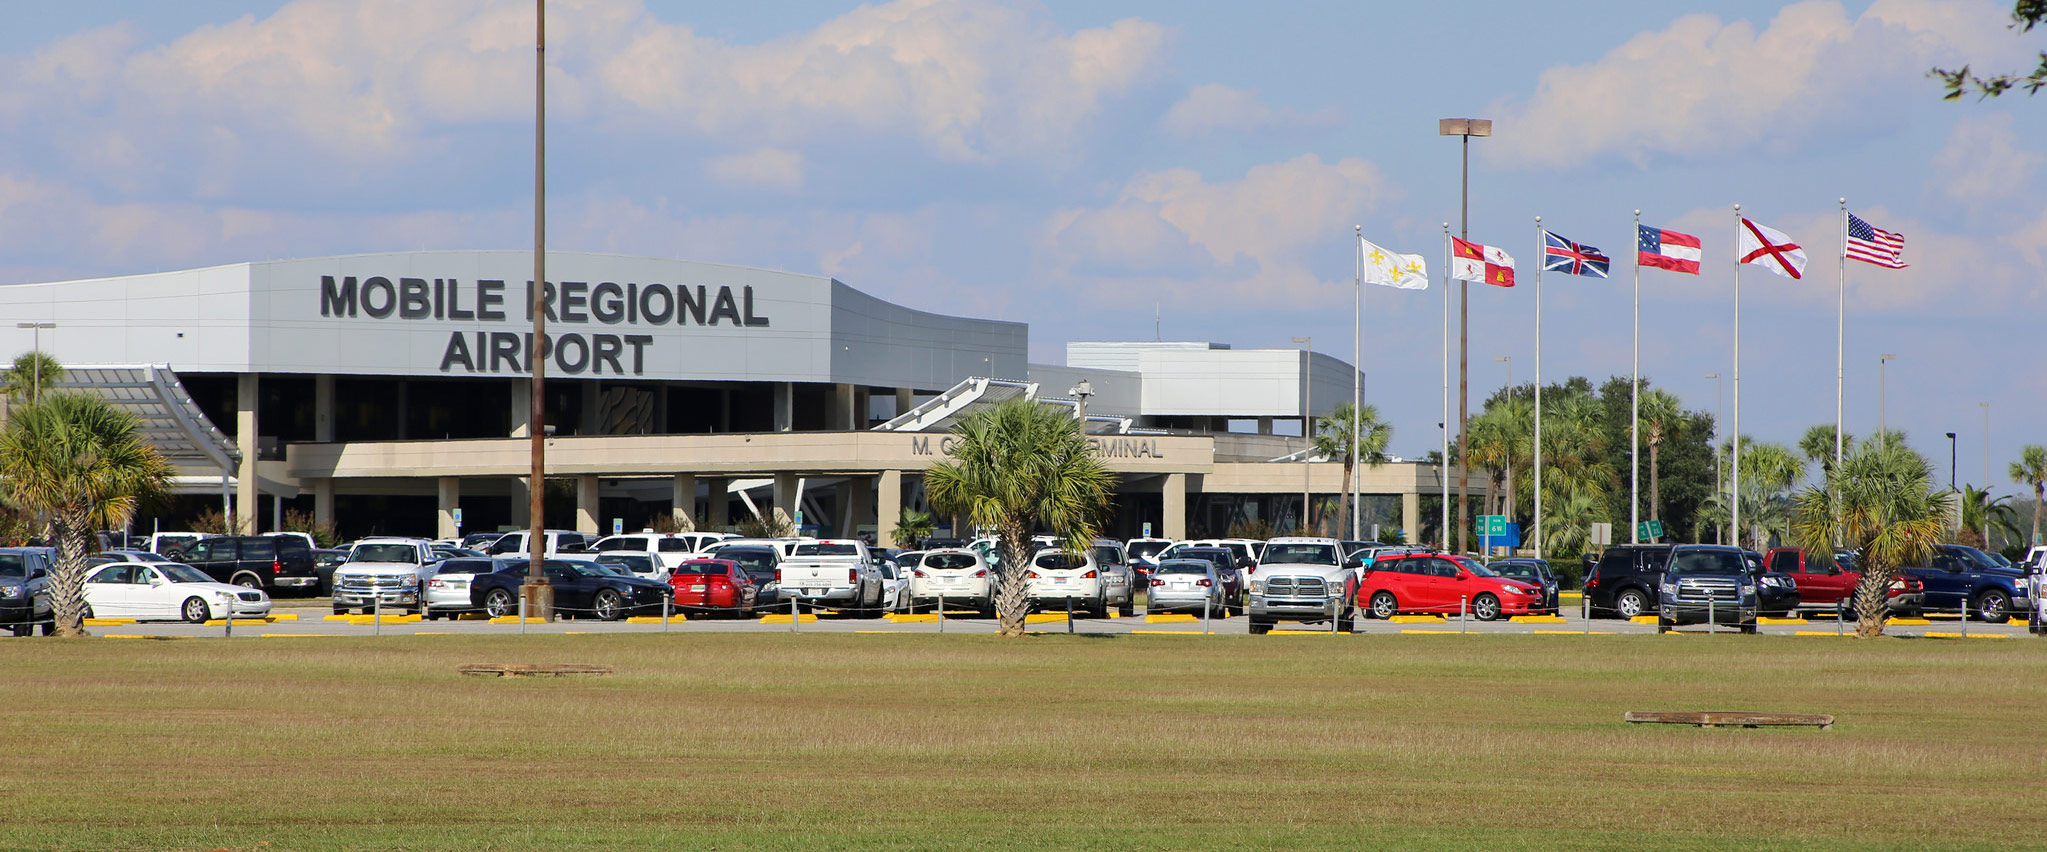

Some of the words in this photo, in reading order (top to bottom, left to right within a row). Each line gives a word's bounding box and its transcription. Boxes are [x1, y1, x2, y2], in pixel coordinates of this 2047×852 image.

[320, 275, 506, 320] MOBILE
[526, 280, 769, 326] REGIONAL
[439, 331, 653, 375] AIRPORT
[912, 435, 933, 456] M.
[1083, 438, 1164, 458] RMINAL
